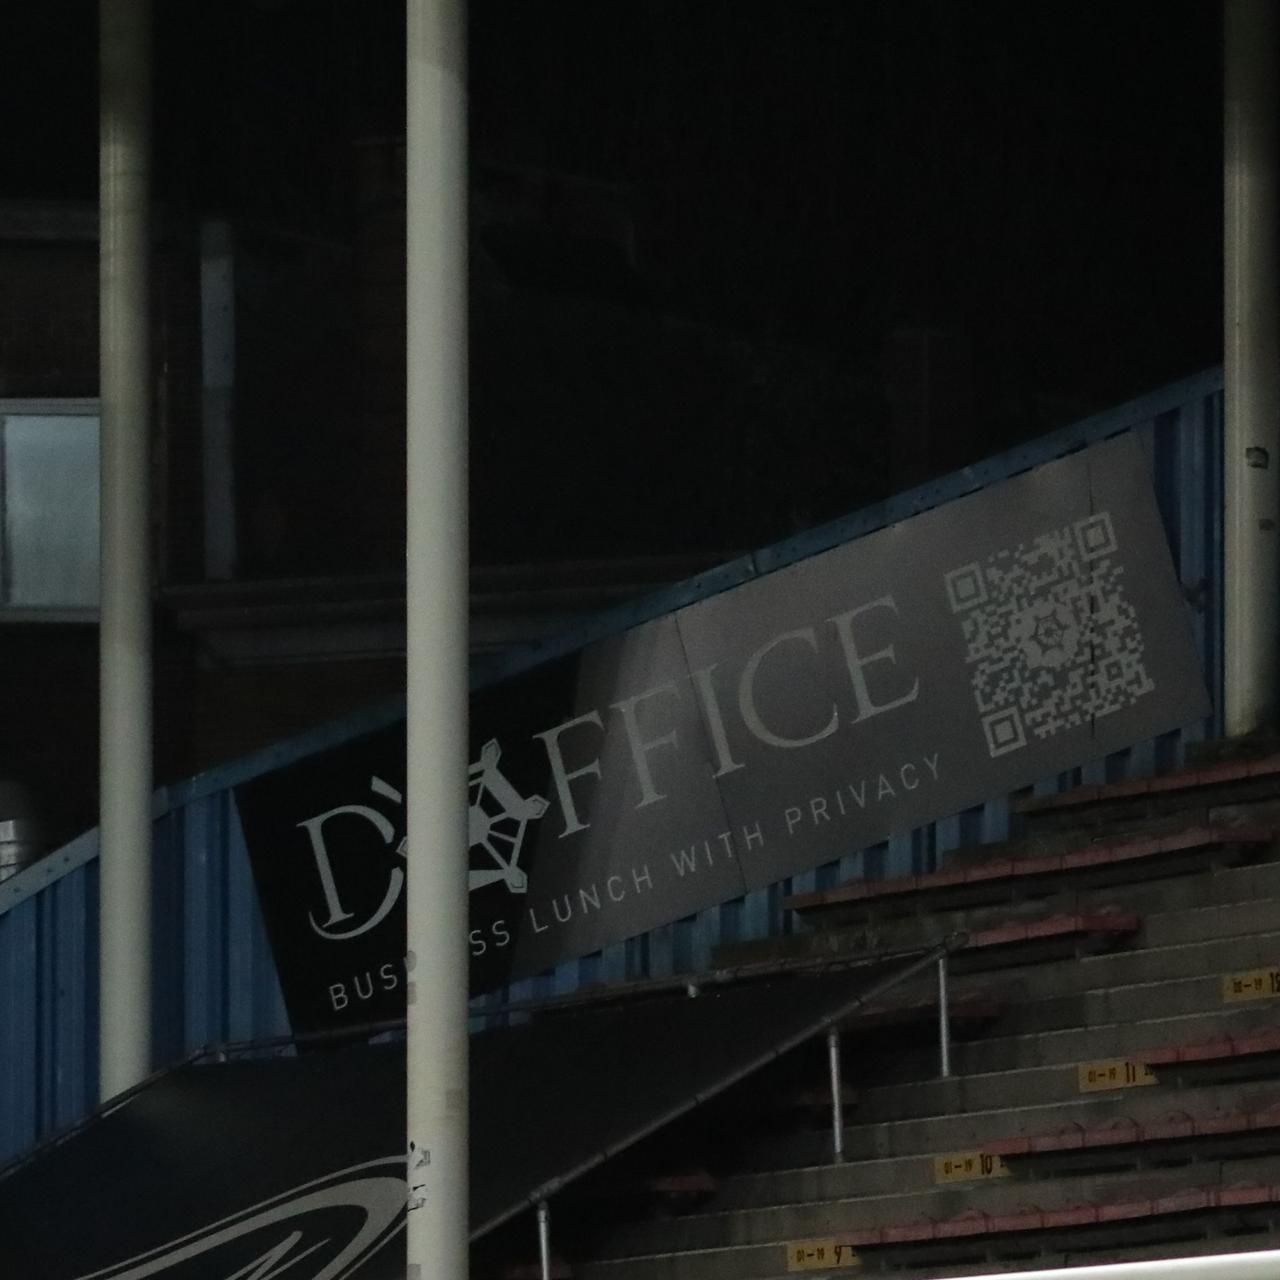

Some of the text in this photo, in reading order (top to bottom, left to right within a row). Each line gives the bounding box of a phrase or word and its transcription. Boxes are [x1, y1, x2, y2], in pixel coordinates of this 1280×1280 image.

[328, 752, 940, 1012] BUSSS LUNCH WITH PRIVACY
